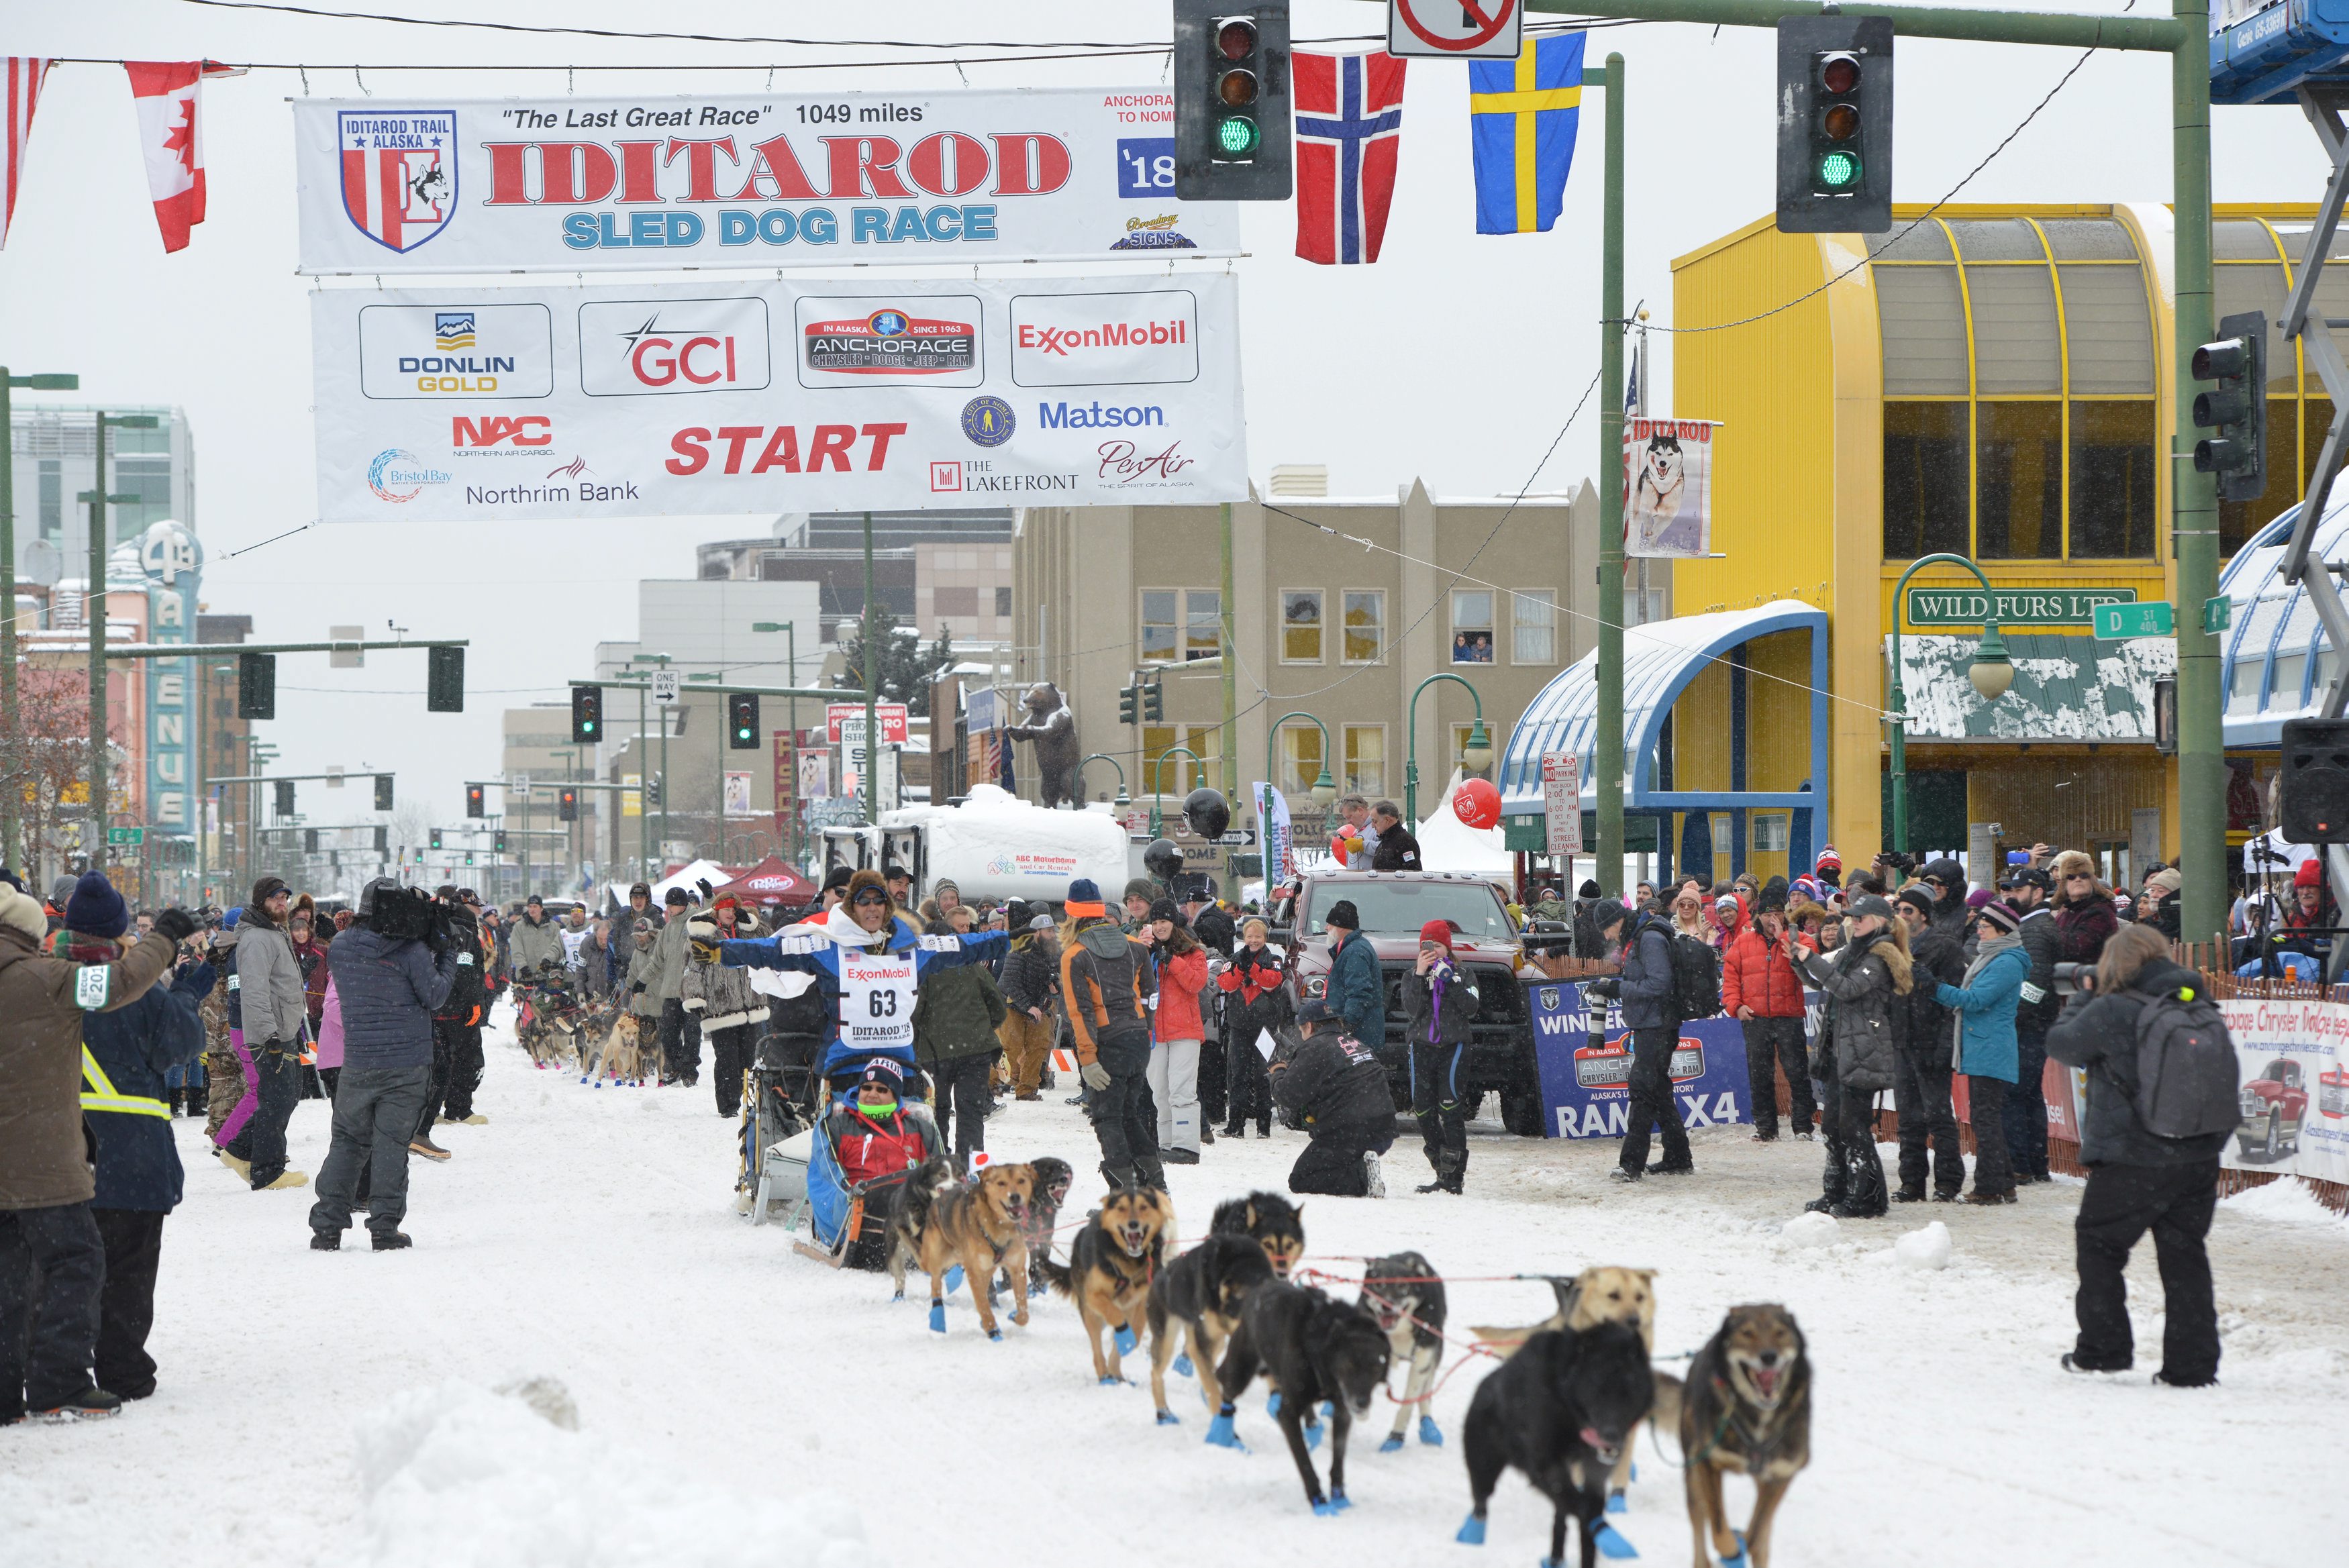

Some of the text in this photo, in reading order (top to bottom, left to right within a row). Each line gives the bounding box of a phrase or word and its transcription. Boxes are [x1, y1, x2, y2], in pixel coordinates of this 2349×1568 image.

[1104, 95, 1174, 107] ANCHORA
[566, 109, 619, 128] Last
[626, 106, 693, 127] Great
[797, 104, 852, 123] 1049
[860, 103, 923, 123] miles
[1117, 111, 1174, 122] TO NOM
[346, 119, 449, 134] IDITAROD TRAIL
[373, 134, 423, 148] ALASKA
[481, 132, 1072, 206] IDITAROD
[562, 204, 998, 250] SLED DOG RACE
[1126, 213, 1179, 231] Broadway
[1130, 231, 1177, 246] SIGNS
[823, 325, 868, 333] IN ALASKA
[913, 325, 961, 333] SINCE 1963
[813, 338, 968, 353] ANCHORAGE
[1018, 320, 1185, 356] ExxonMobil
[399, 356, 515, 373] DONLIN
[632, 336, 736, 387] GCI
[812, 354, 970, 367] CHRYSLER DODGE JEEP RAM
[417, 376, 498, 392] GOLD
[966, 402, 979, 416] CITY
[993, 401, 1010, 417] NOME
[1039, 401, 1163, 429] Matson
[452, 415, 552, 447] NAC
[1632, 419, 1712, 443] IDITAROD
[664, 422, 908, 476] START
[964, 461, 993, 472] THE
[391, 469, 453, 484] Bristol Bay
[966, 474, 1079, 492] LAKEFRONT
[466, 481, 640, 504] Northrim Bank
[1917, 596, 2121, 618] WILD FURS LT
[2110, 610, 2155, 631] D ST
[2140, 621, 2158, 632] 400
[656, 674, 674, 682] ONE
[656, 683, 675, 691] WAY
[1545, 768, 1576, 781] NO PARKING
[1548, 790, 1562, 798] 2:00
[1550, 843, 1579, 851] CLEANING
[1034, 855, 1077, 864] Motorhome
[753, 879, 790, 890] Pepper
[90, 967, 103, 993] 201
[848, 967, 911, 982] ExxonMobil
[869, 989, 897, 1018] 63
[852, 1022, 911, 1036] IDITAROD '18
[2258, 1002, 2299, 1040] Chrysler
[2303, 1002, 2331, 1041] Dodge
[1596, 1047, 1620, 1055] ALASKA
[1683, 1065, 1699, 1075] RAM
[1582, 1073, 1617, 1084] CHRYSLER
[1675, 1092, 1740, 1129] X4
